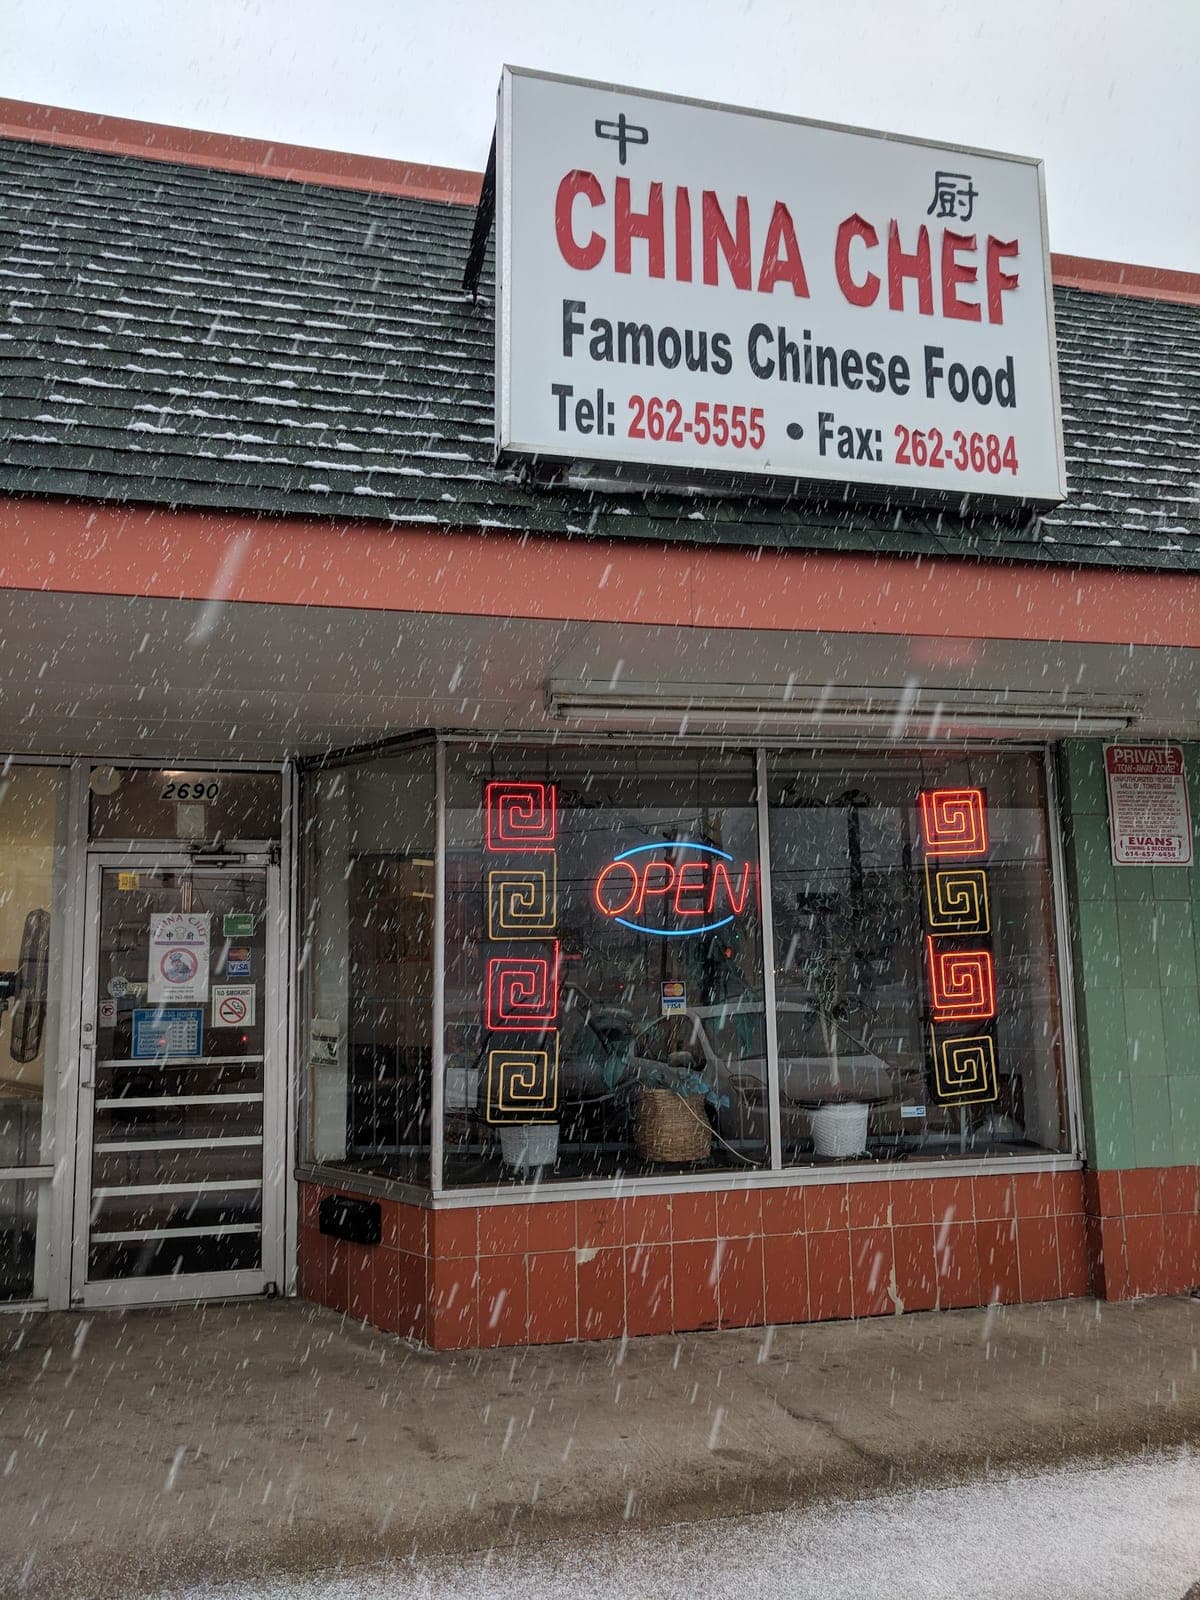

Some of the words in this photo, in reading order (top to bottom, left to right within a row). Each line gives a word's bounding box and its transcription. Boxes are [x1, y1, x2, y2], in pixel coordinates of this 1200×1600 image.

[595, 113, 648, 165] 中
[555, 169, 810, 298] CHINA
[834, 212, 1020, 325] CHEF
[562, 299, 733, 375] Famous
[747, 323, 911, 395] Chinese
[924, 345, 1017, 409] Food
[551, 384, 615, 434] Tel:
[627, 395, 766, 450] 262-5555
[818, 411, 883, 462] Fax:
[894, 424, 1019, 476] 262-3684
[1113, 748, 1176, 764] PRIVATE
[1154, 764, 1176, 773] ZONE
[161, 783, 219, 799] 2690
[1128, 837, 1172, 846] EVANS
[595, 860, 751, 916] OPEN
[230, 963, 249, 971] VISA
